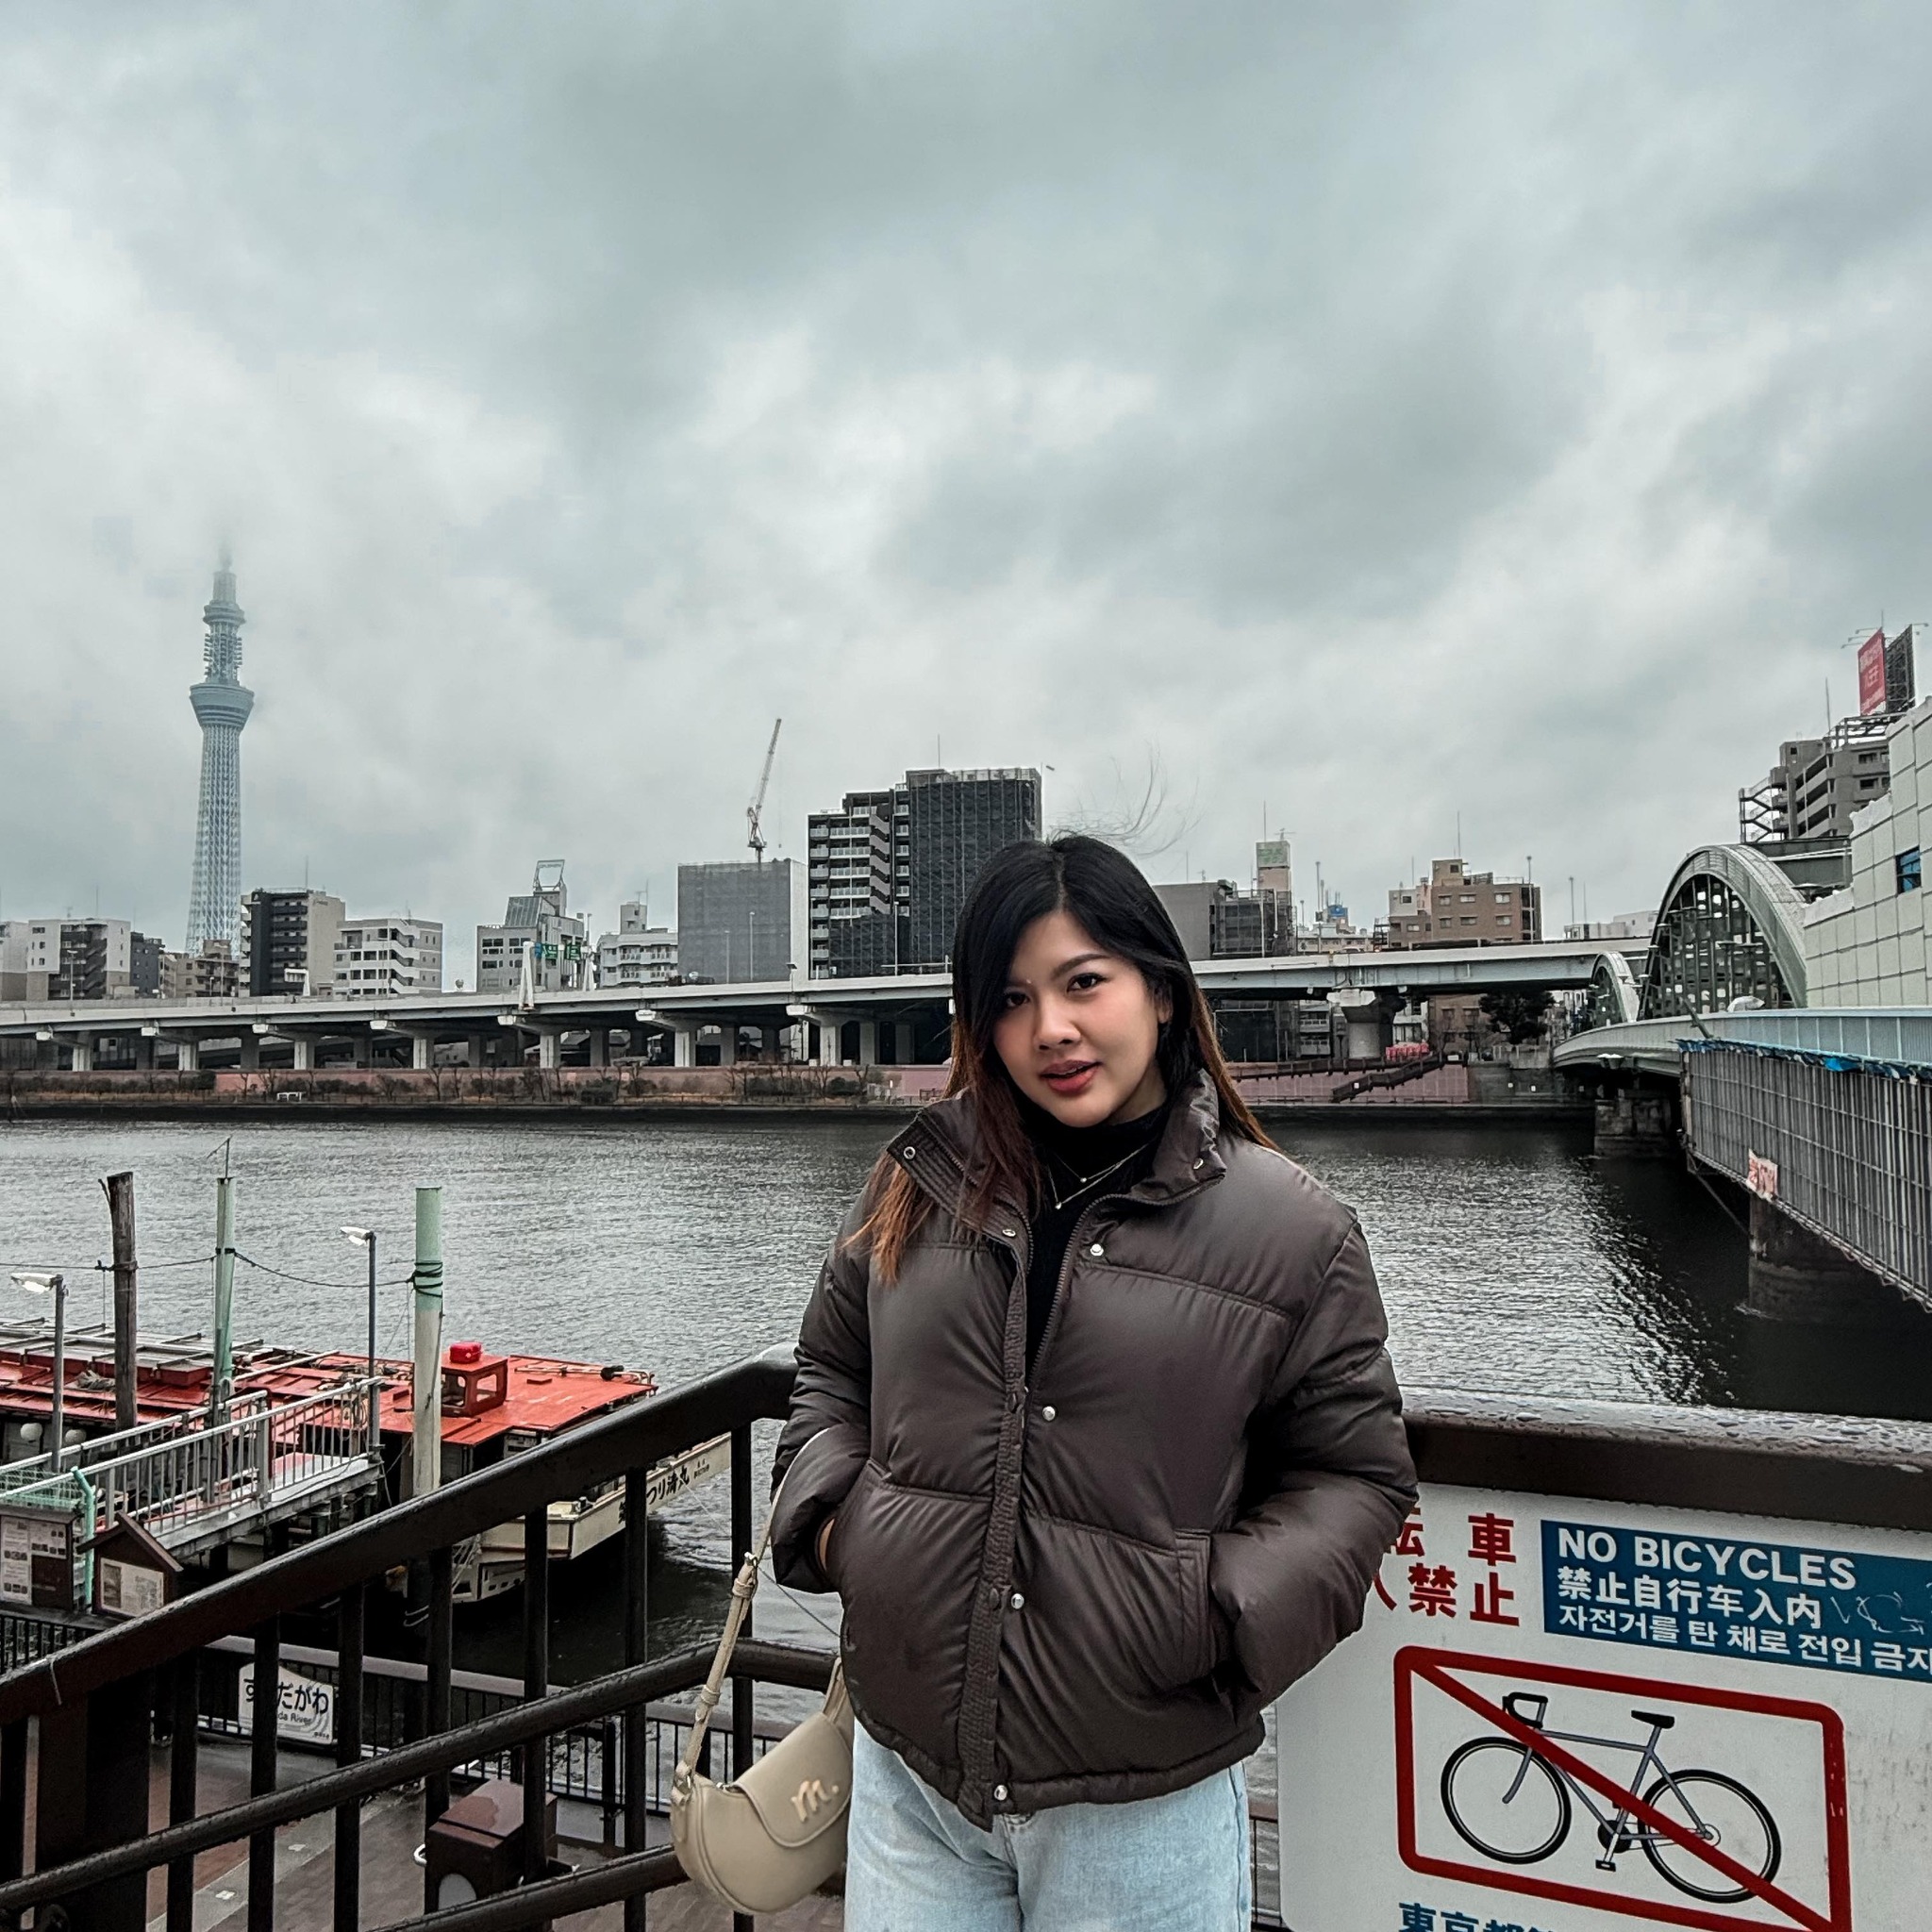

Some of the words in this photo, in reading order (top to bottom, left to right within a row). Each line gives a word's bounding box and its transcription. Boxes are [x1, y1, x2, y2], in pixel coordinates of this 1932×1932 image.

[1557, 1527, 1618, 1563] NO
[1634, 1536, 1857, 1591] BICYCLES
[1558, 1604, 1680, 1644] 자전거를
[1688, 1619, 1719, 1648] 탄
[1725, 1624, 1791, 1656] 채로
[1797, 1633, 1862, 1668] 전입
